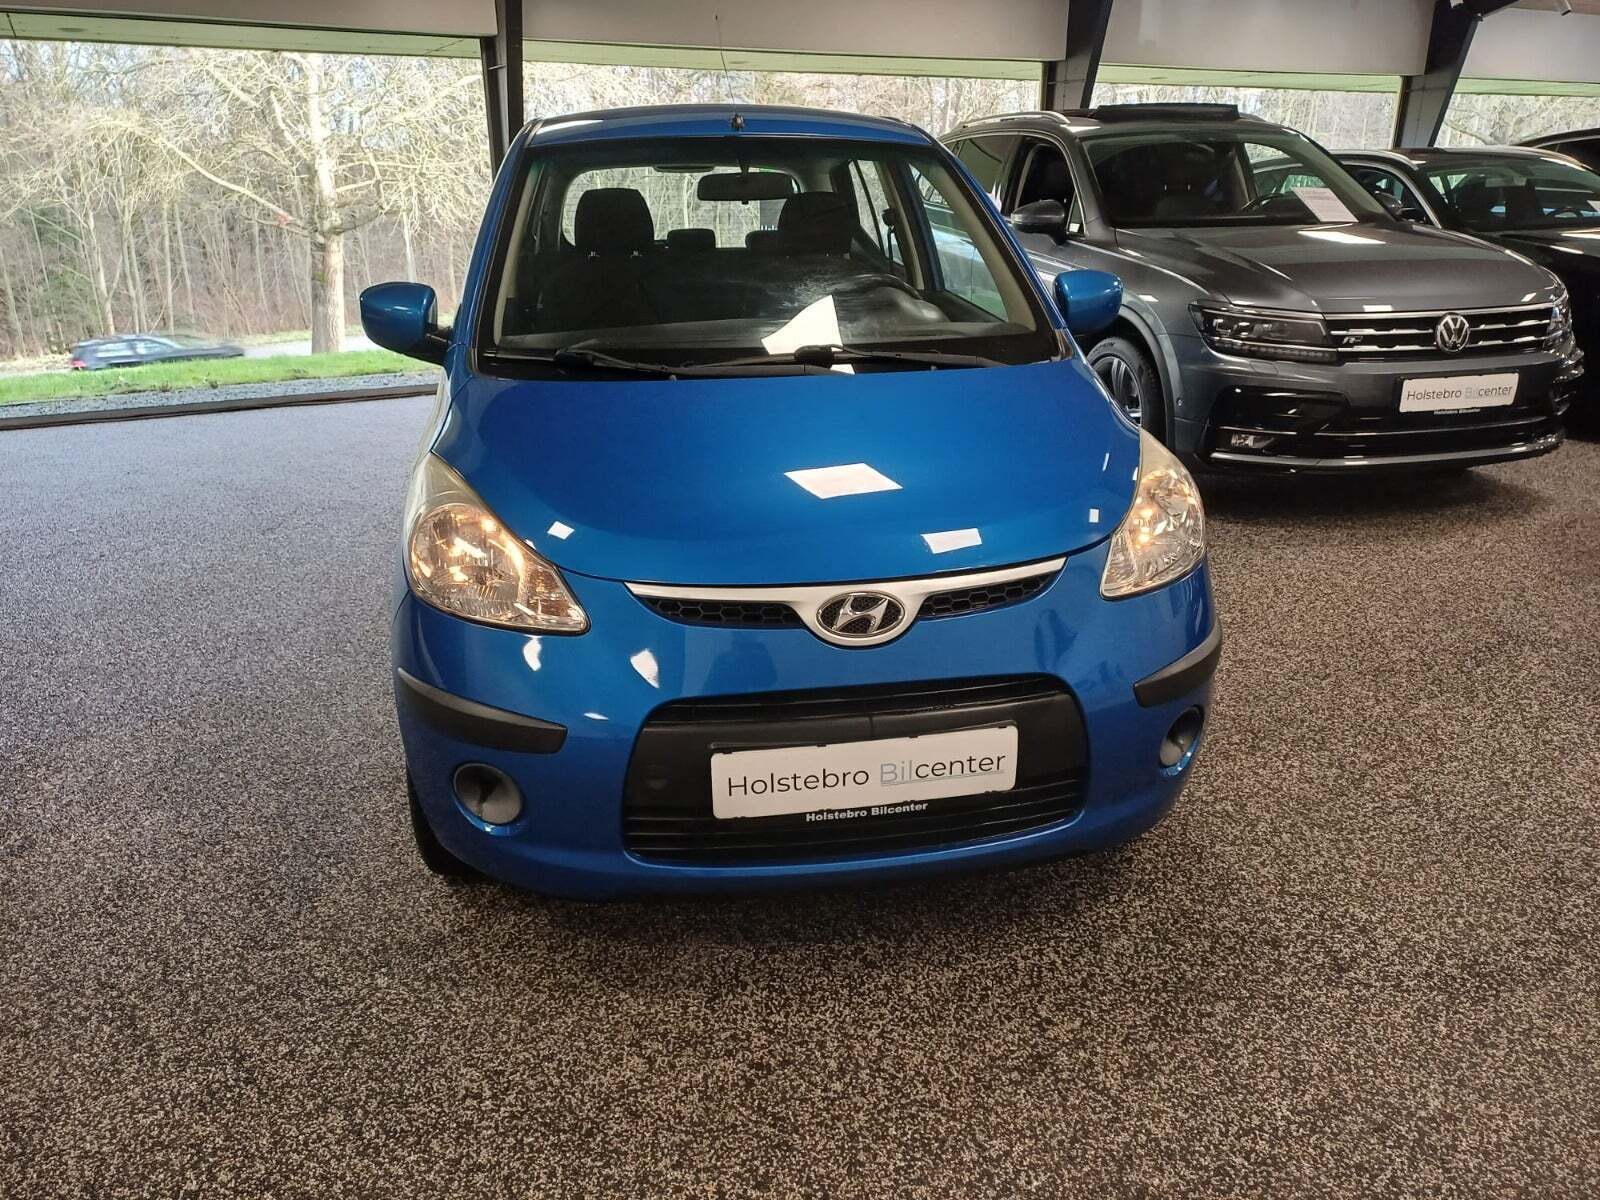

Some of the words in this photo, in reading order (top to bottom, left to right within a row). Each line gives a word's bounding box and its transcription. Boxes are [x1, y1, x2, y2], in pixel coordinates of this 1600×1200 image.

[1406, 388, 1462, 401] Holstebro
[727, 767, 870, 797] Holstebro
[880, 753, 1007, 785] Bilcenter
[806, 808, 868, 822] Holstebro
[871, 802, 929, 816] Bilcenter
